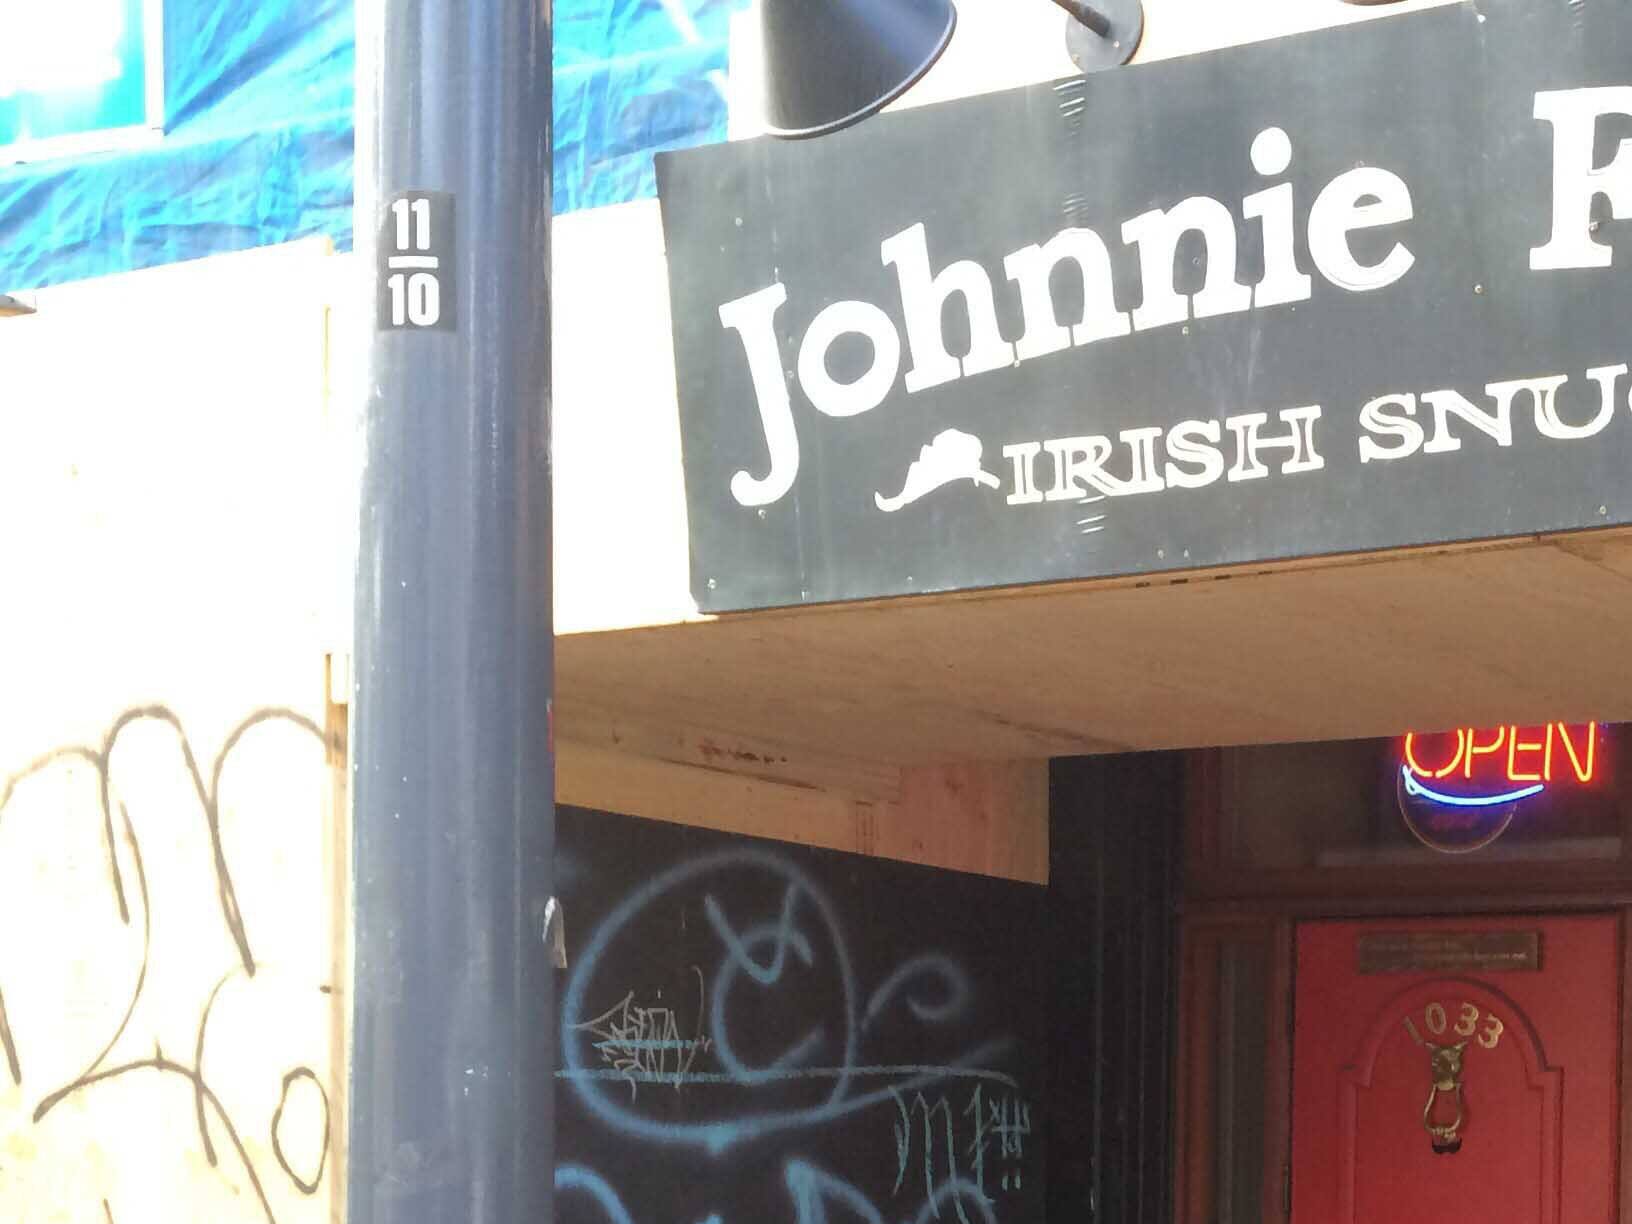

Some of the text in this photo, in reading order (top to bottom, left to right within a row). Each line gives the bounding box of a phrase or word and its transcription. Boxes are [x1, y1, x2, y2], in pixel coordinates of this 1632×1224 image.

[391, 197, 431, 251] 11
[387, 272, 441, 327] 10
[718, 126, 1414, 508] Johnnie
[1002, 403, 1322, 506] IRISH
[1404, 720, 1596, 783] OPEN
[1403, 1002, 1505, 1049] 1033
